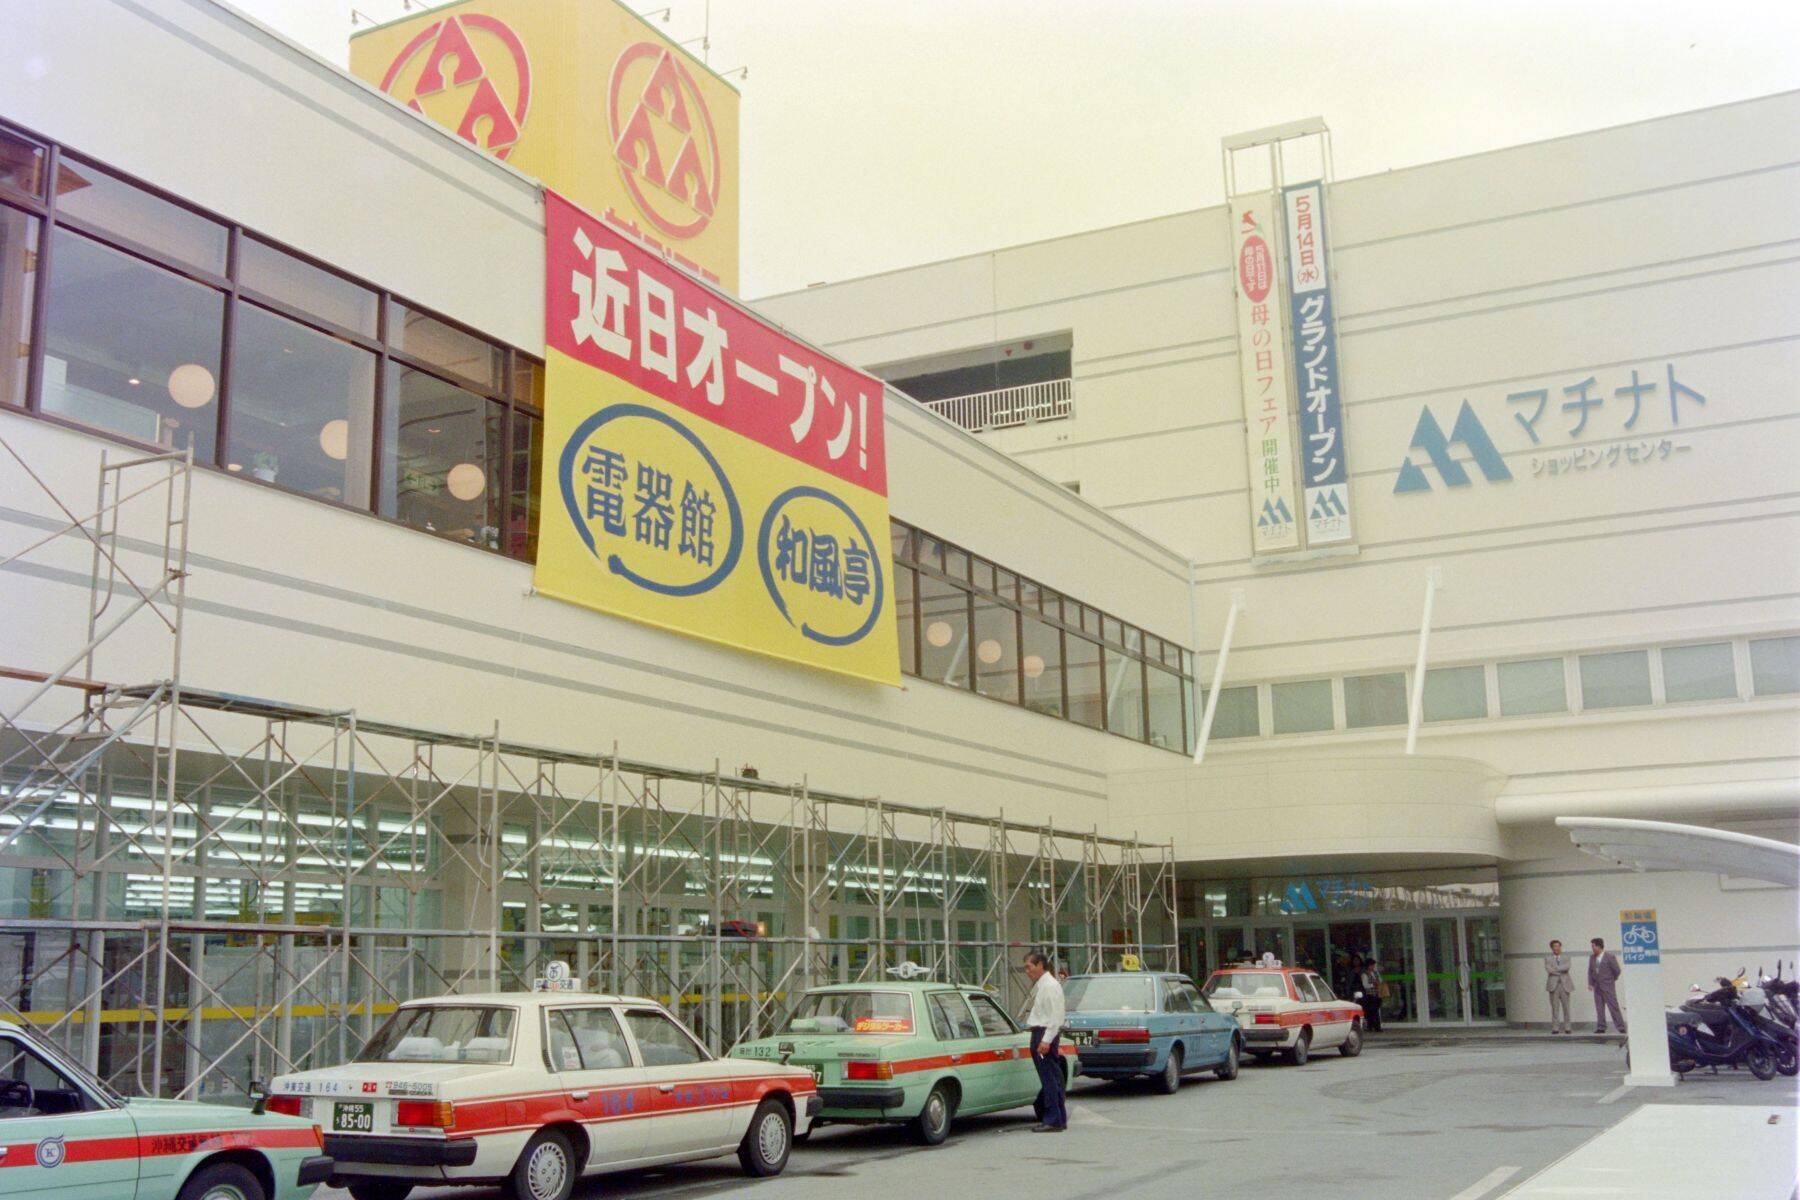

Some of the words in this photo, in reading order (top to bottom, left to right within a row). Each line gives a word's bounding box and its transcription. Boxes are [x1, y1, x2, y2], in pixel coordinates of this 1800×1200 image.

[1300, 295, 1338, 483] グランドオープン
[1506, 363, 1706, 445] マチナト
[1531, 438, 1692, 478] ショッピングセンター
[582, 445, 717, 568] 電器館
[776, 514, 871, 606] 和風亭
[754, 1047, 771, 1057] 132
[341, 1114, 371, 1129] 85-00
